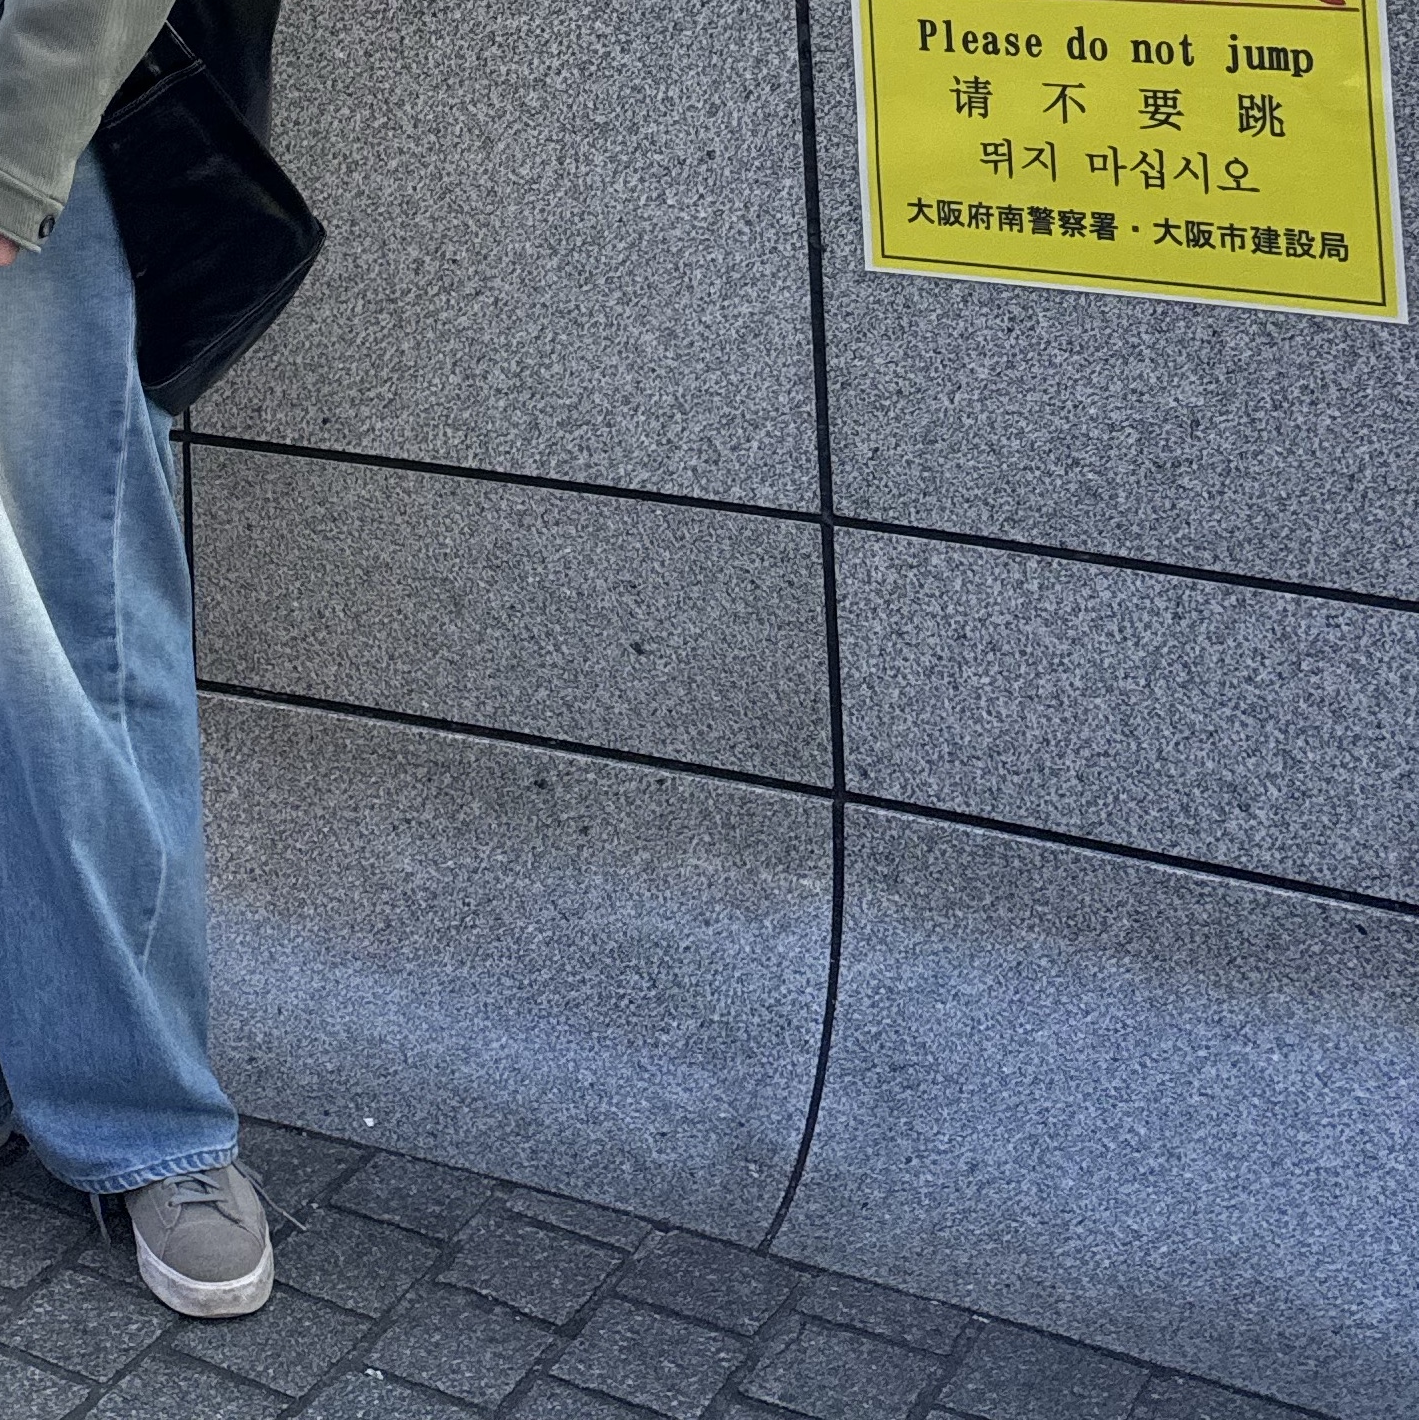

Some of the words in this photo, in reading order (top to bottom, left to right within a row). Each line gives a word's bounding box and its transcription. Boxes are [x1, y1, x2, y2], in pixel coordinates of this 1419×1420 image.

[917, 18, 1043, 58] Please
[1066, 26, 1109, 63] do
[1131, 34, 1195, 67] not
[1225, 34, 1315, 77] jump
[1086, 145, 1261, 194] 마십시오
